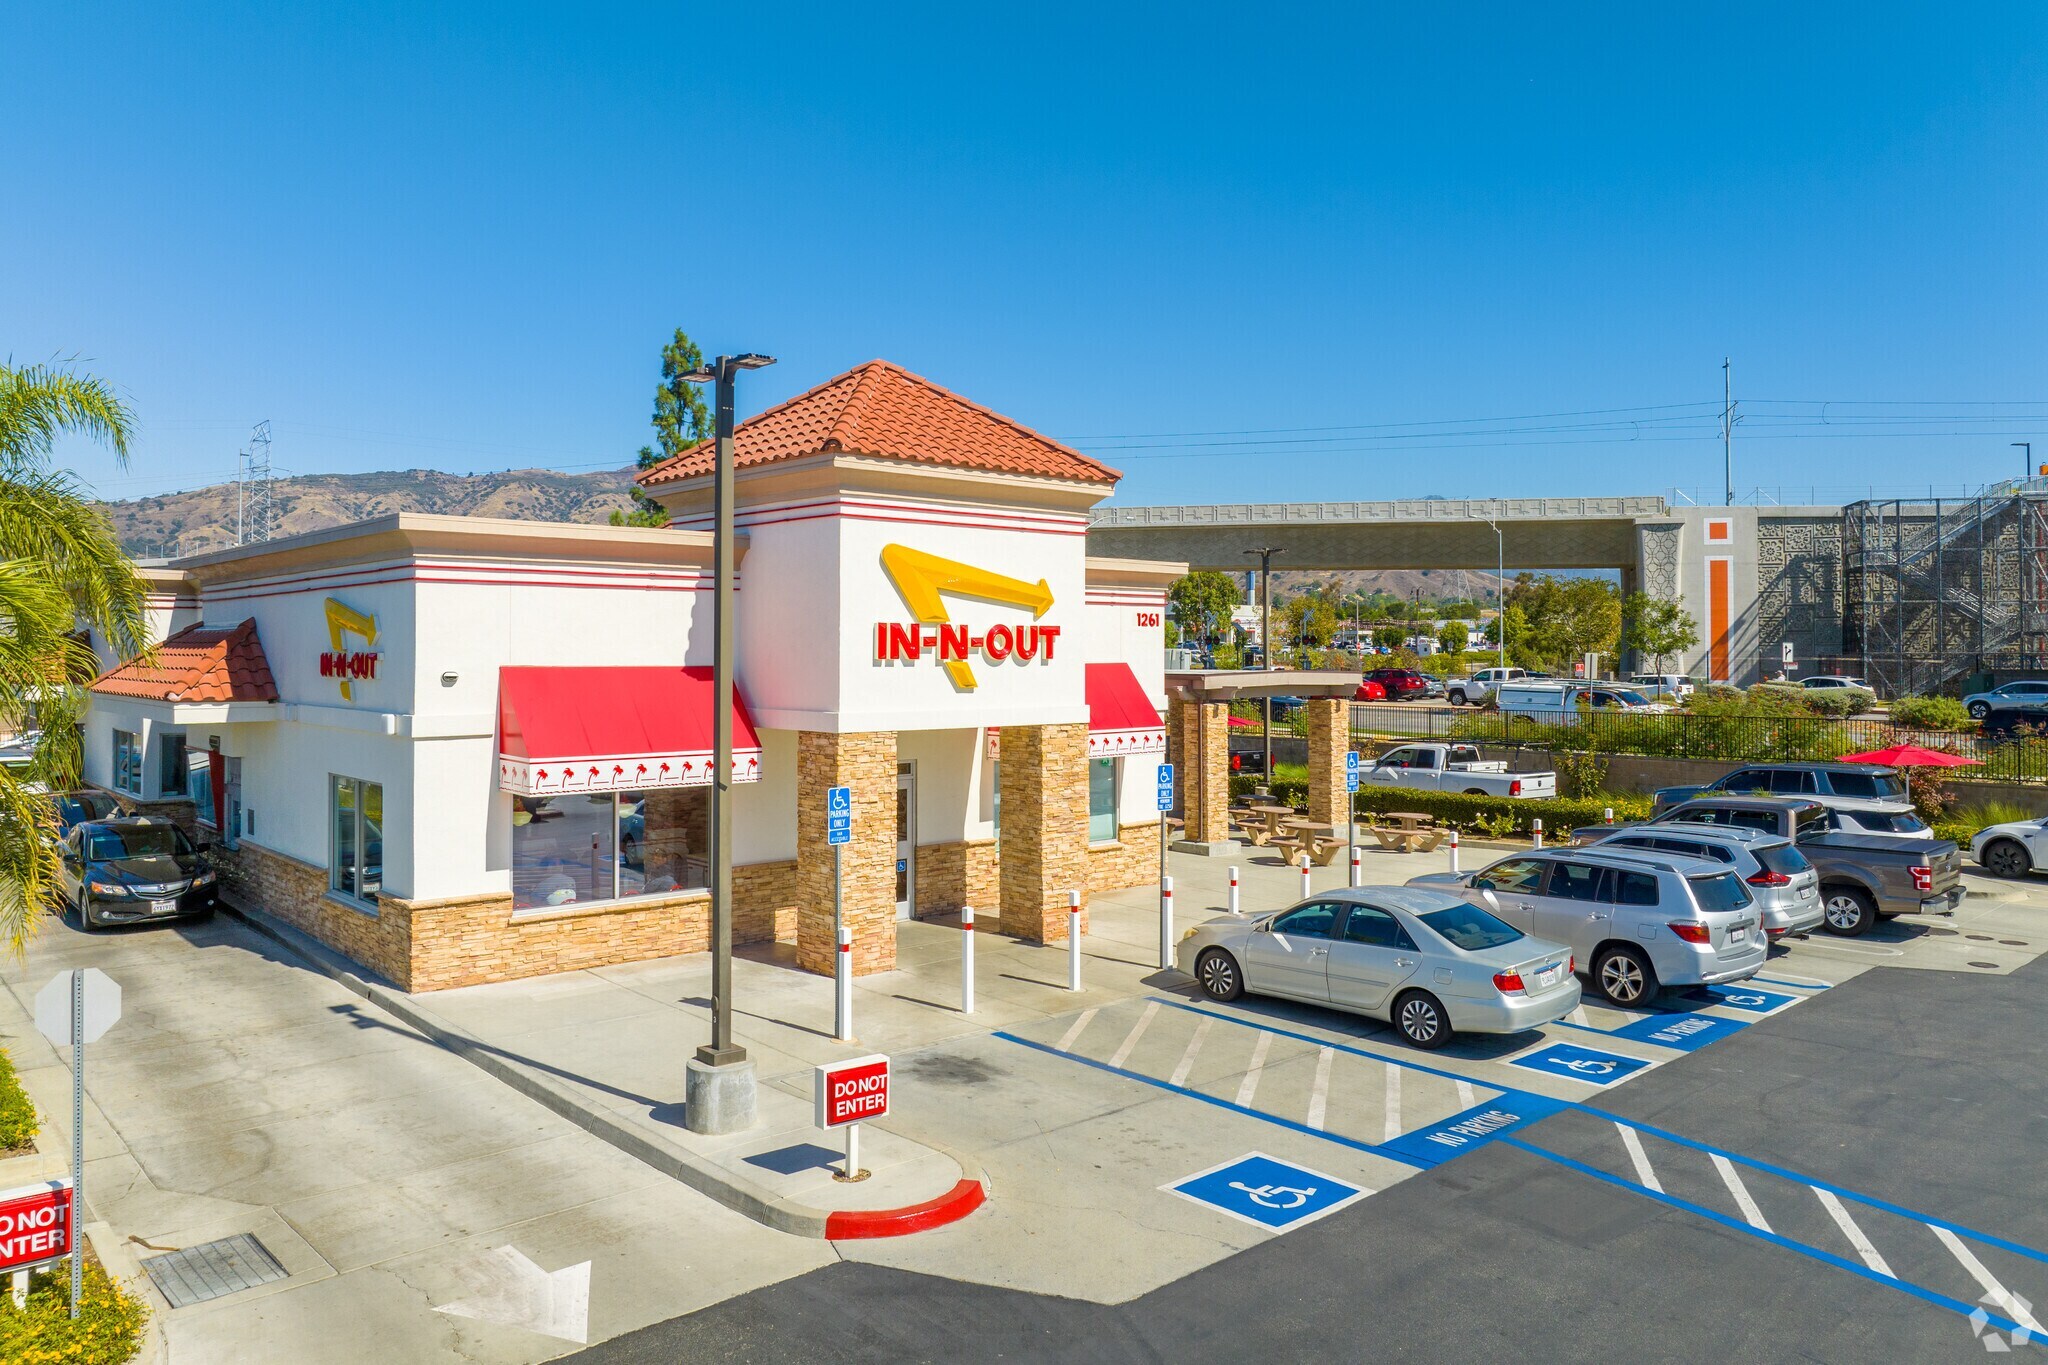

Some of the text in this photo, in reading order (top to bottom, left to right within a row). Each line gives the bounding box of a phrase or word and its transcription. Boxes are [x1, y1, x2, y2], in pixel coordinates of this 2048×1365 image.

[1137, 613, 1159, 627] 1261
[876, 621, 1061, 662] IN-N-OUT
[320, 652, 378, 679] IN-N-OUT
[830, 809, 850, 818] PARKING
[834, 819, 846, 828] ONLY
[835, 1074, 888, 1098] DO NOT
[836, 1093, 885, 1117] ENTER
[1425, 1110, 1521, 1147] NO PARKING
[0, 1203, 69, 1236] O NOT
[0, 1229, 65, 1258] NTER
